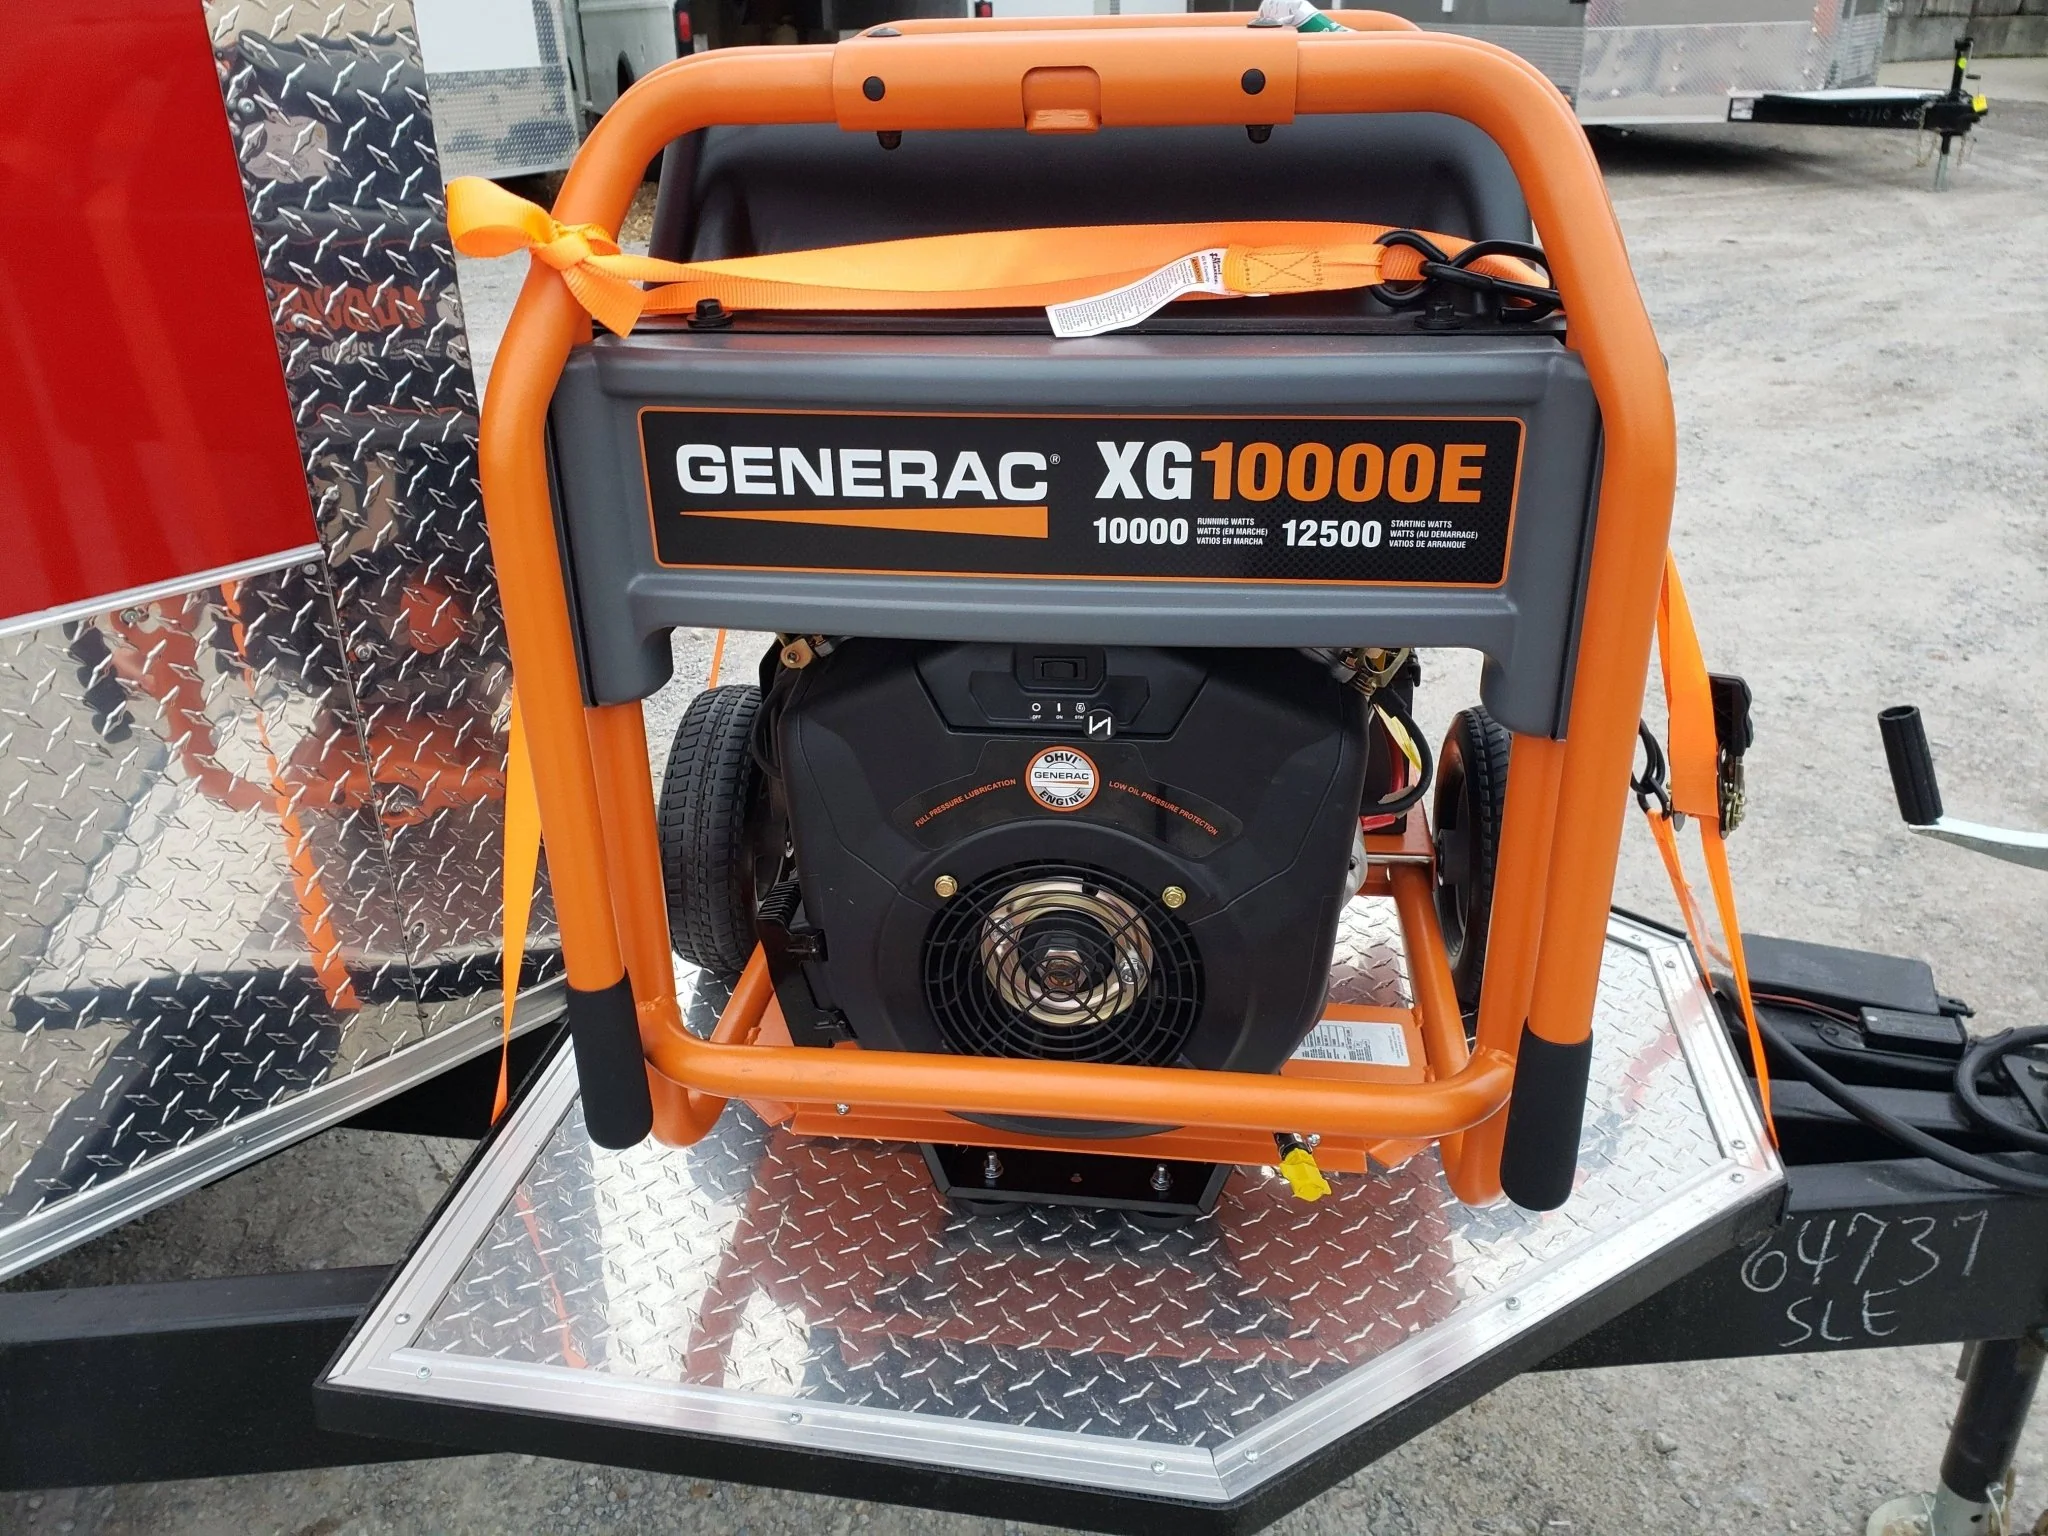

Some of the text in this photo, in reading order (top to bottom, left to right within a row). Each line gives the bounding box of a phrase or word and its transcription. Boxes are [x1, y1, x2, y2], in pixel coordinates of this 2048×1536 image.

[1197, 517, 1255, 526] RUNNING WATTS
[1391, 520, 1452, 528] STARTING WATTS
[1093, 517, 1189, 545] 10000
[1197, 527, 1268, 537] WATTS (EN MARCHE)
[1282, 518, 1382, 547] 12500
[1390, 530, 1415, 538] WATTS
[1416, 530, 1429, 539] (AU
[1196, 537, 1221, 545] VATIOS
[1222, 537, 1232, 545] EN
[1389, 540, 1467, 549] VATIOS DE ARRANQUE
[1034, 771, 1089, 780] GENERAC
[915, 778, 1017, 827] FULL PRESSURE LUBRICATION
[1039, 790, 1086, 806] ENGINE
[1108, 780, 1219, 836] LOW OIL PRESSURE PROTECTION
[1741, 1209, 1988, 1292] 64737
[1779, 1288, 1899, 1347] SLE
